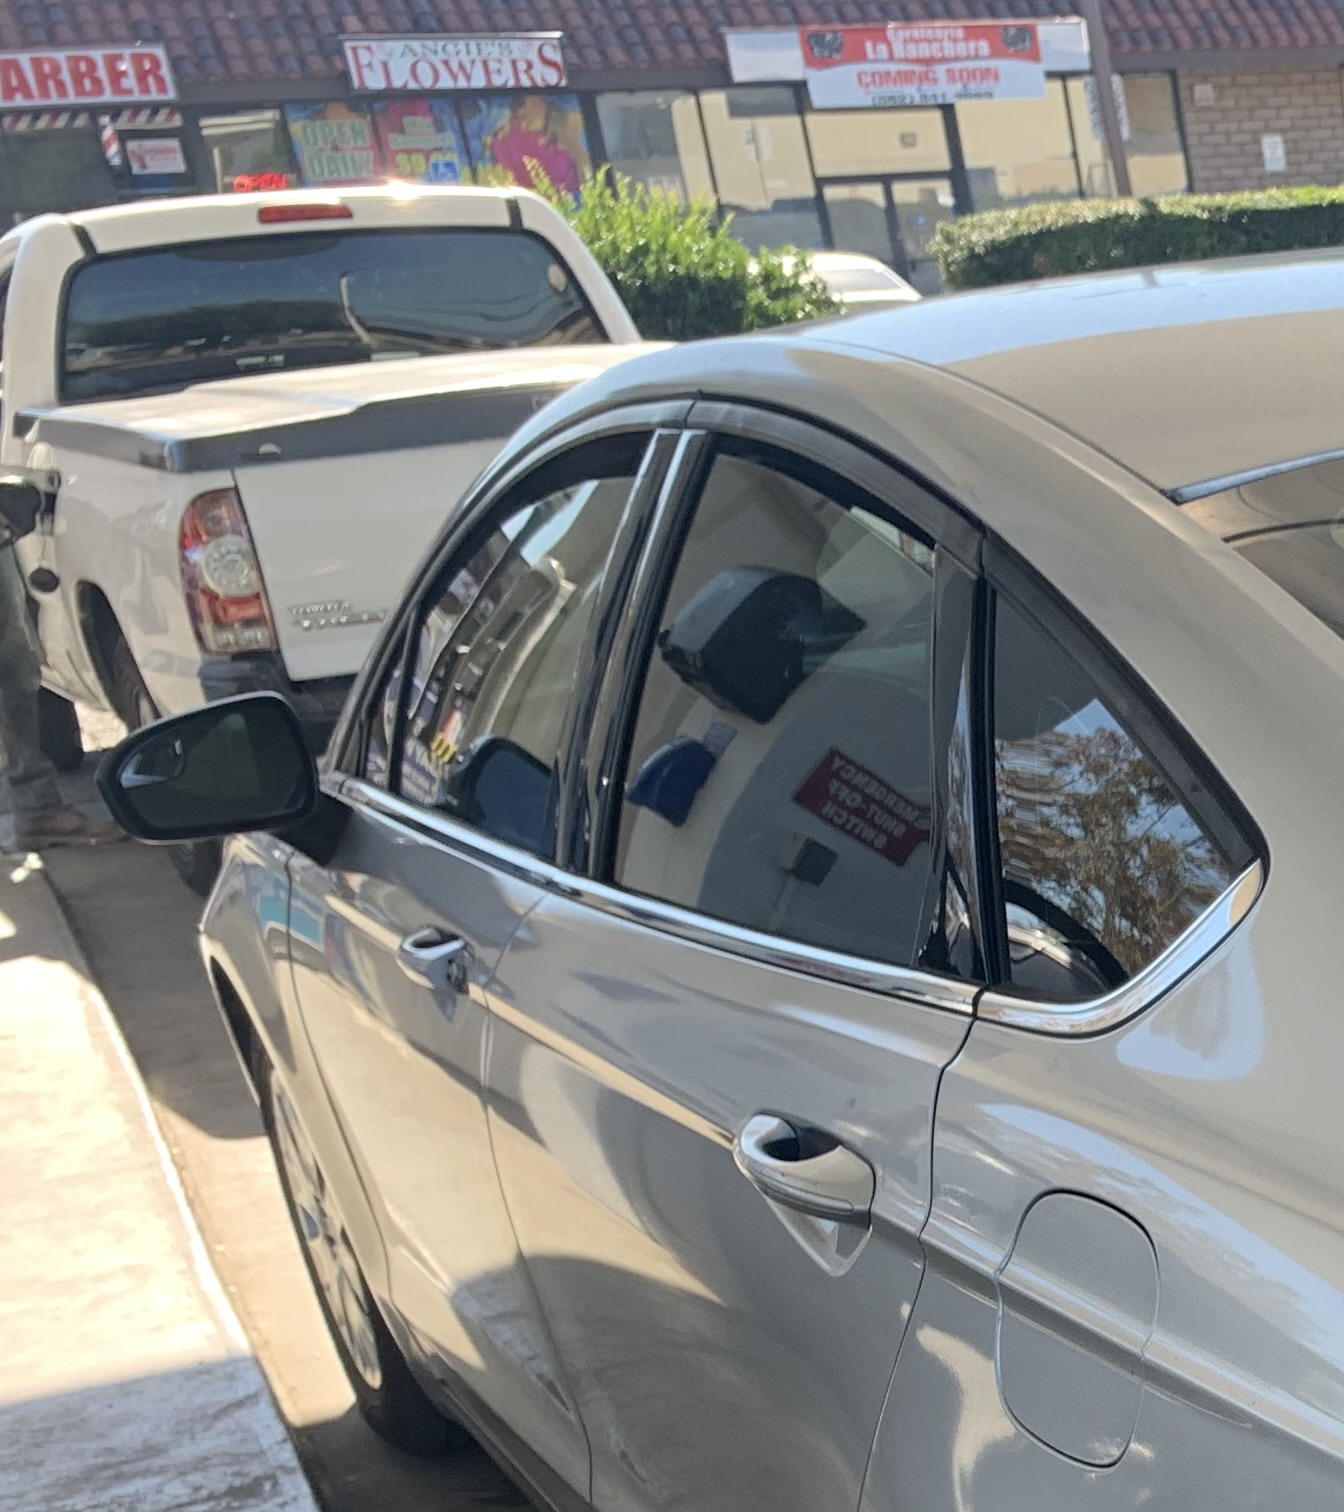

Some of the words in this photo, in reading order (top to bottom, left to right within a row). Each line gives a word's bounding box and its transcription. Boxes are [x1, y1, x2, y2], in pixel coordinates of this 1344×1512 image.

[864, 39, 889, 60] La
[891, 38, 990, 60] Ranchera
[350, 41, 566, 88] FLOWERS
[856, 68, 938, 91] COMING
[945, 66, 999, 86] SOON
[301, 120, 369, 147] OPEN
[304, 151, 373, 179] DAILY
